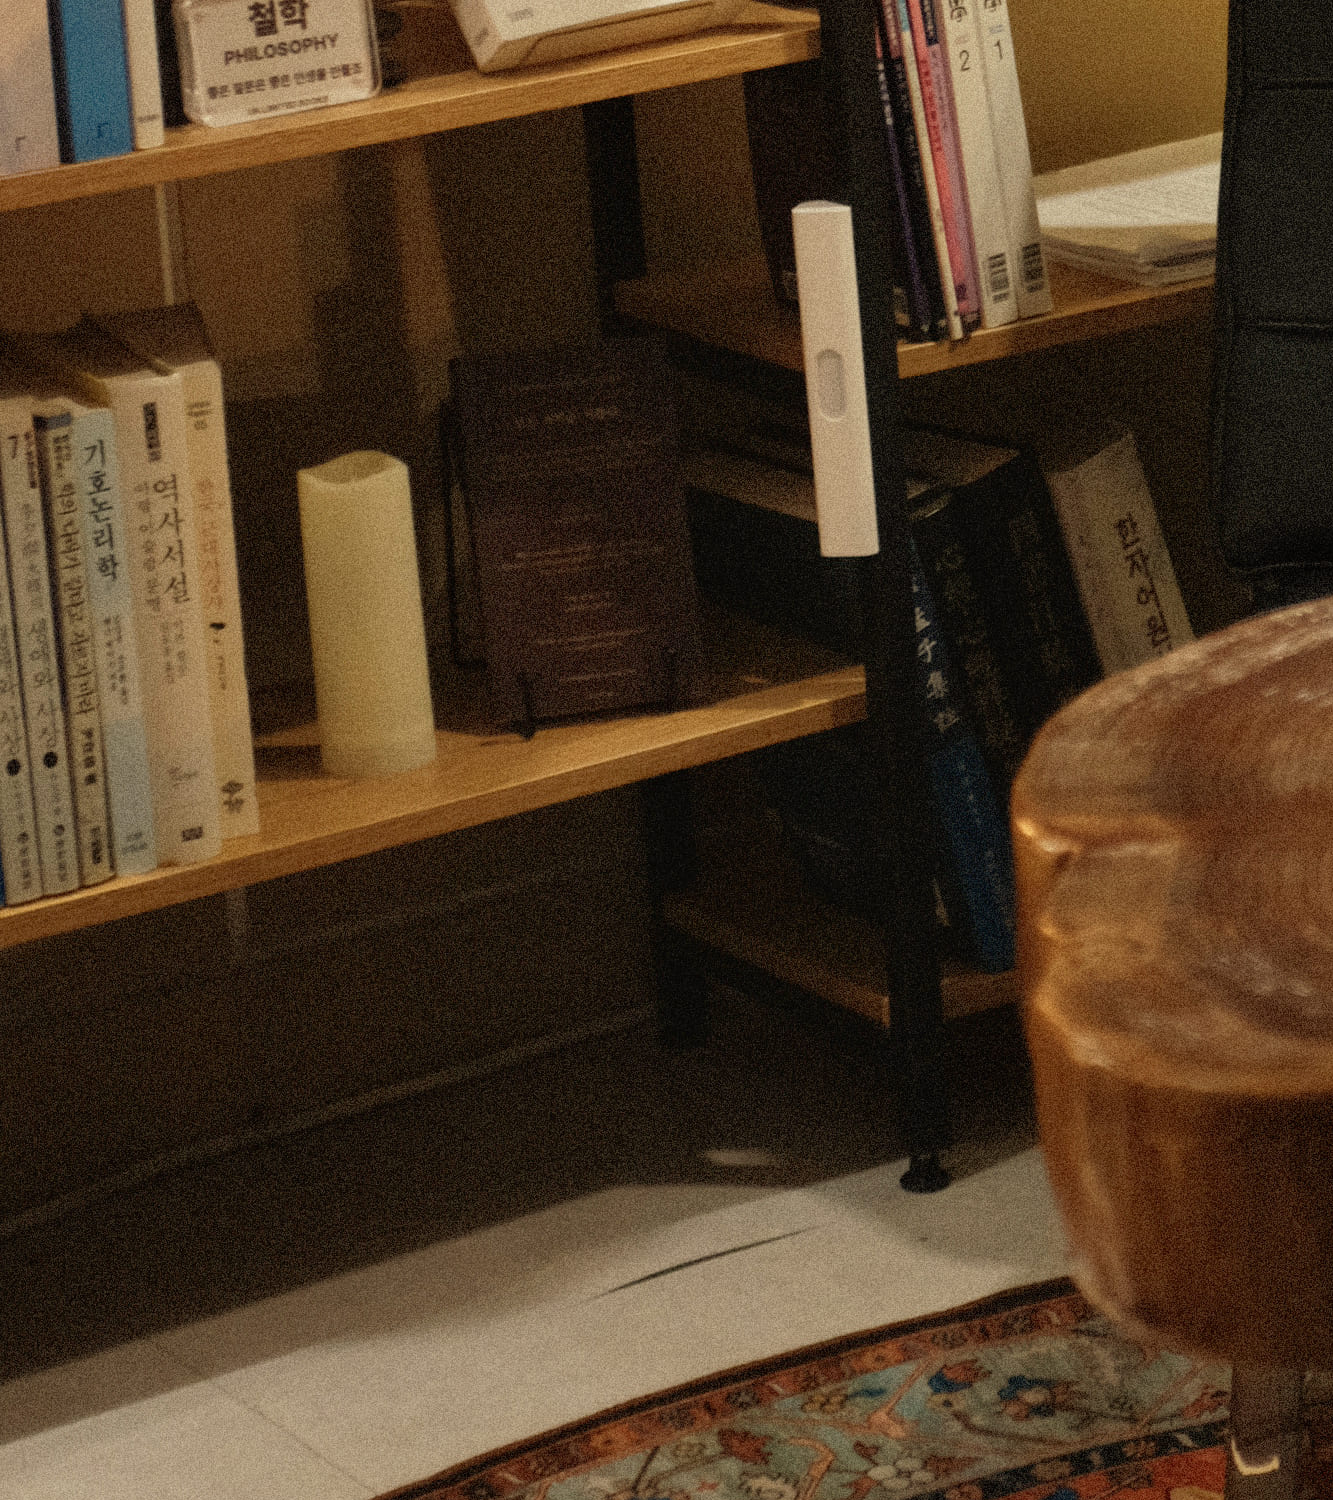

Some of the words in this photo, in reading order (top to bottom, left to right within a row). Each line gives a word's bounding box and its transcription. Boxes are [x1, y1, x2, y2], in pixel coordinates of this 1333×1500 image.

[223, 32, 340, 66] PHILOSOPHY
[957, 48, 972, 74] 2
[82, 438, 121, 584] 기호논리학
[152, 472, 191, 607] 역사서설
